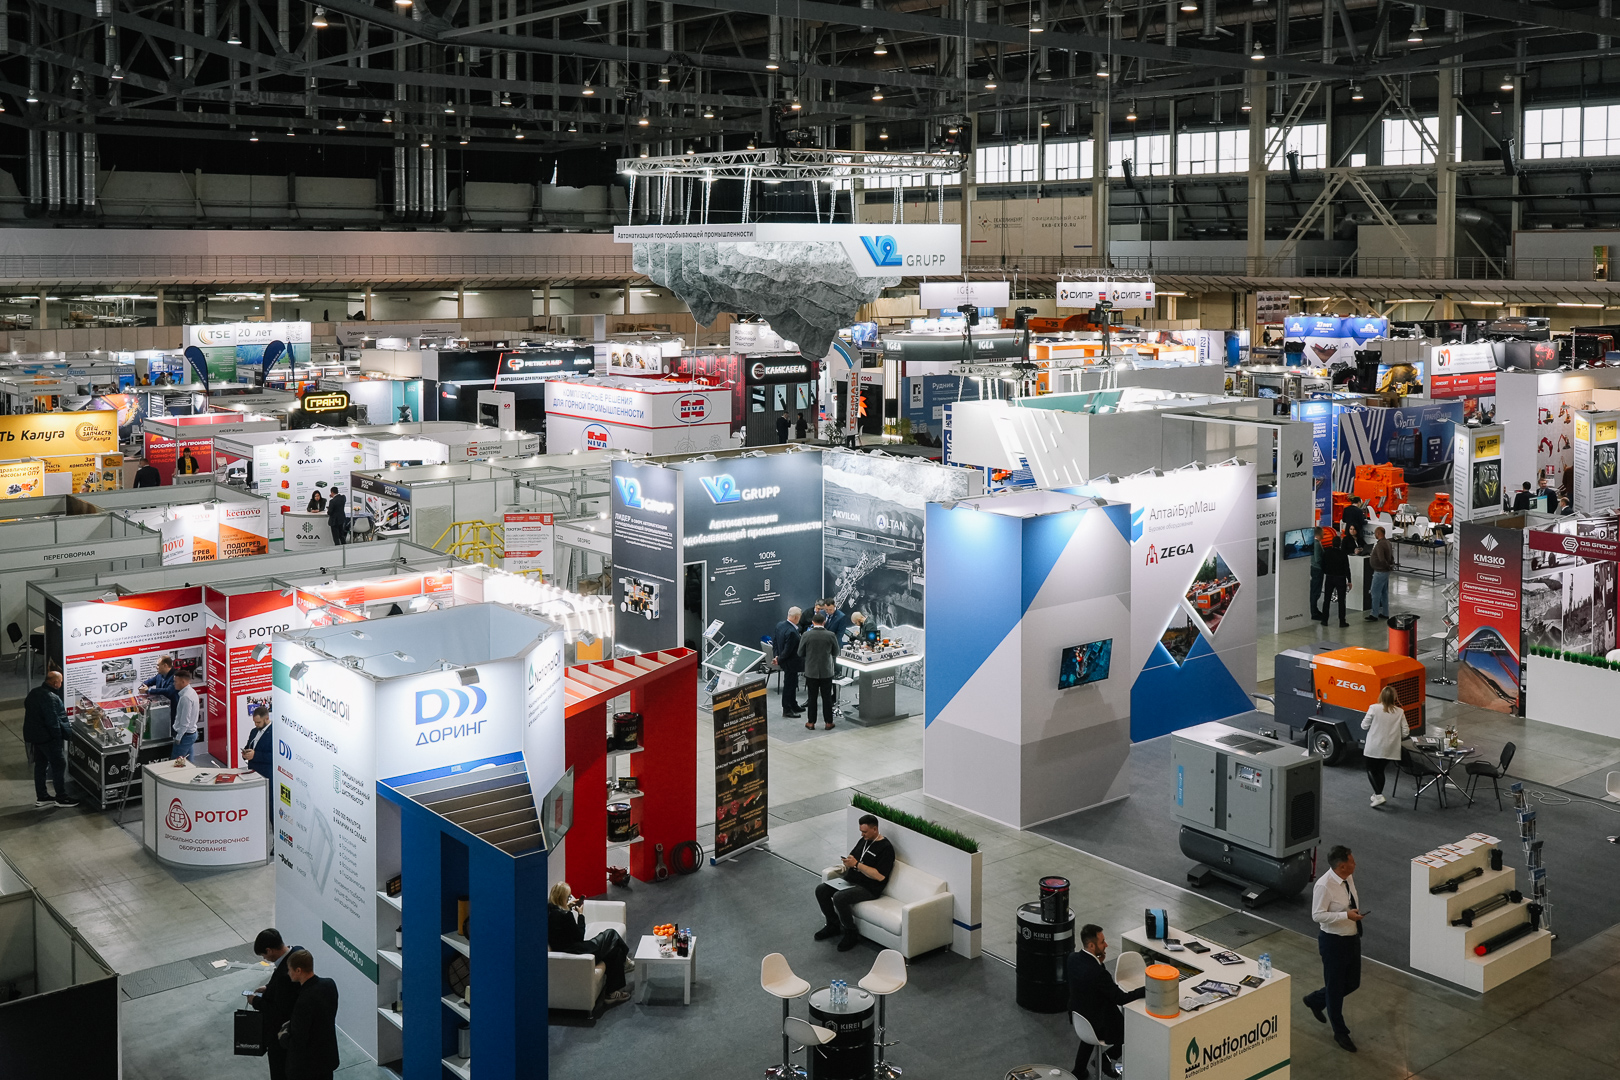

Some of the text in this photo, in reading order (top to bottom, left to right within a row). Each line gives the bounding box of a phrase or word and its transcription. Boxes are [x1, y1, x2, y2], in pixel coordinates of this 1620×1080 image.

[654, 230, 703, 239] горнодобывающей
[704, 230, 754, 238] промышленности
[859, 234, 946, 267] V2 GRUPP
[1069, 291, 1094, 299] СИПР
[1120, 291, 1141, 299] СИПР
[208, 330, 230, 339] TSE
[238, 328, 272, 337] 20 лет
[886, 342, 902, 350] IGEA
[978, 340, 994, 350] IGEA
[932, 382, 954, 390] Рудник
[563, 388, 632, 406] КОМПЛЕКСНЫЕ РЕШЕНИЯ
[310, 398, 342, 408] ГРАНЧ
[552, 398, 644, 419] ДЛЯ ГОРНОЙ ПРОМЫШЛЕННОСТИ
[20, 430, 65, 441] Калуга
[587, 440, 607, 448] NIVA
[1286, 470, 1308, 479] РУДПРОМ
[699, 474, 780, 505] V2 GRUPP
[226, 508, 260, 517] keenovo
[832, 510, 860, 522] AKVILON
[1150, 501, 1216, 521] АлтайБурМаш
[1148, 521, 1193, 533] Буровое оборудование
[683, 530, 746, 546] одобывающей
[162, 538, 184, 553] novo
[226, 541, 260, 549] ПОДОГРЕВ
[1592, 542, 1617, 551] GROUP
[44, 550, 96, 561] ПЕРЕГОВОРНАЯ
[759, 551, 776, 560] 100%
[1160, 544, 1194, 560] ZEGA
[1463, 595, 1494, 604] Пластинчатые
[1477, 608, 1501, 617] Элеваторы
[158, 612, 199, 627] РОТОР
[84, 622, 128, 637] РОТОР
[249, 624, 290, 638] РОТОР
[845, 652, 862, 661] AKVILON
[880, 651, 900, 660] AKVILON
[872, 676, 894, 686] AKVILON
[1336, 679, 1366, 693] ZEGA
[306, 684, 350, 721] NationalOil
[415, 720, 487, 746] ДОРИНГ
[194, 809, 248, 823] РОТОР
[165, 834, 250, 845] ДРОБИЛЬНО-СОРТИРОВОЧНОЕ
[1033, 931, 1052, 939] KIREI
[840, 1022, 860, 1030] KIREI
[1203, 1014, 1278, 1066] NationalOil
[1185, 1063, 1209, 1080] Authorized
[1210, 1054, 1233, 1069] Distributor
[1233, 1050, 1238, 1058] of
[1239, 1041, 1260, 1056] Lubricants
[1265, 1033, 1278, 1043] Filters
